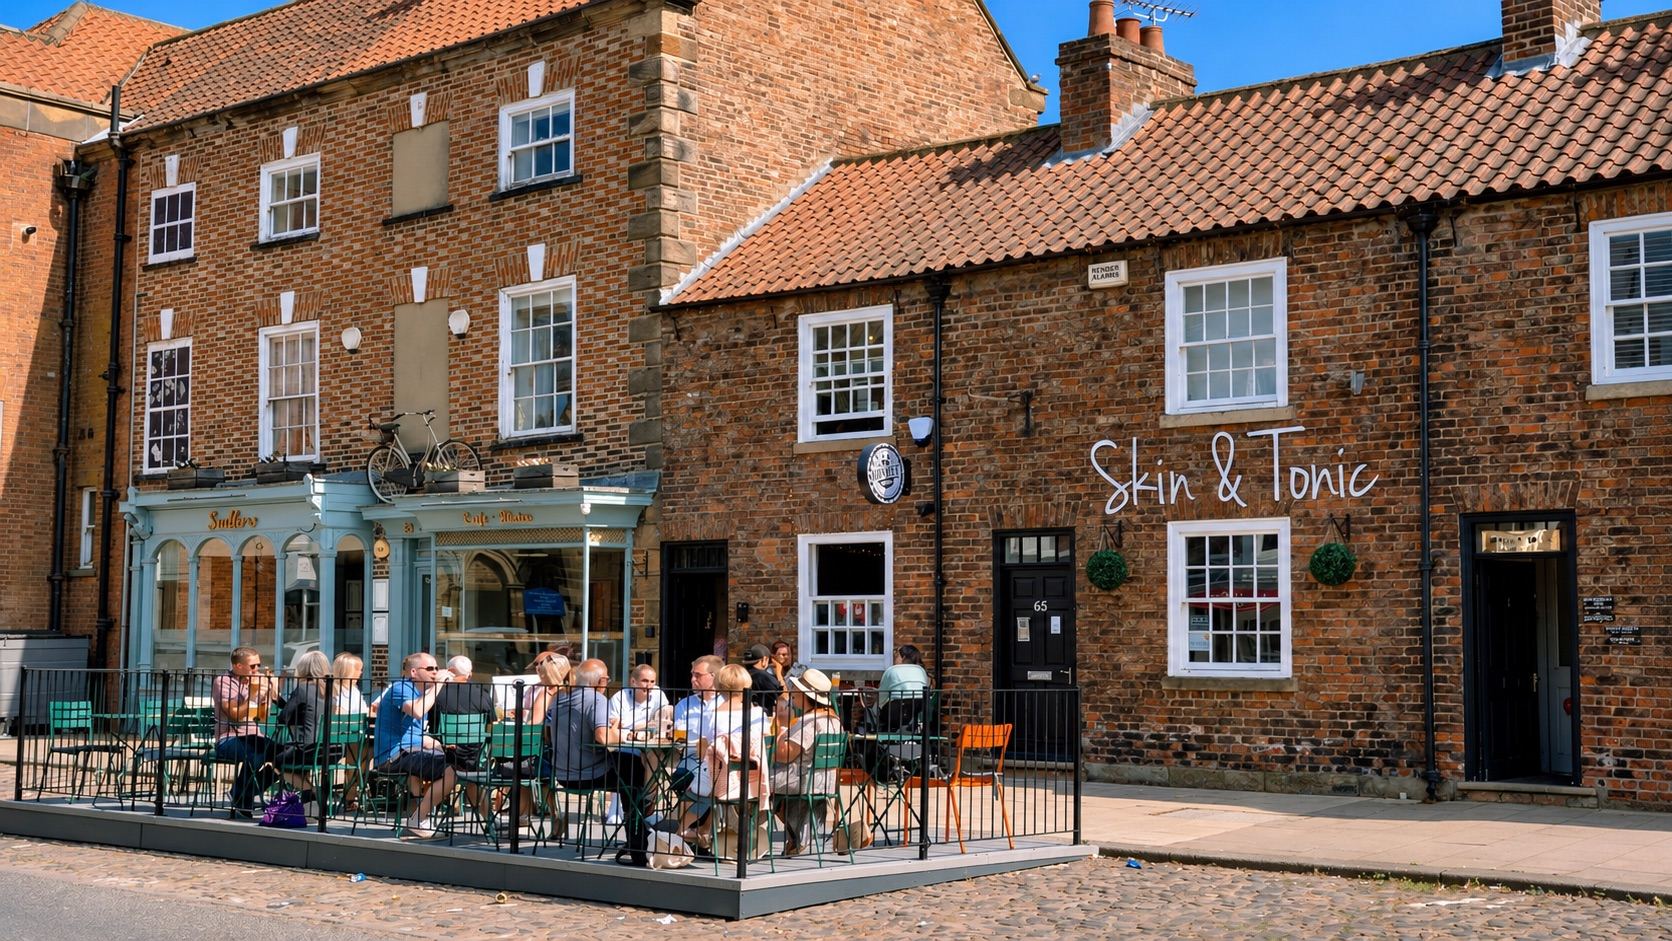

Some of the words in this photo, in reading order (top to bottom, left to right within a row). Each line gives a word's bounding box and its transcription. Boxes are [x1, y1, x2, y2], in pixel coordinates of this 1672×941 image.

[1089, 436, 1196, 515] Skin
[1211, 431, 1248, 507] &
[1246, 425, 1380, 502] Tonic
[1033, 600, 1048, 612] 65
